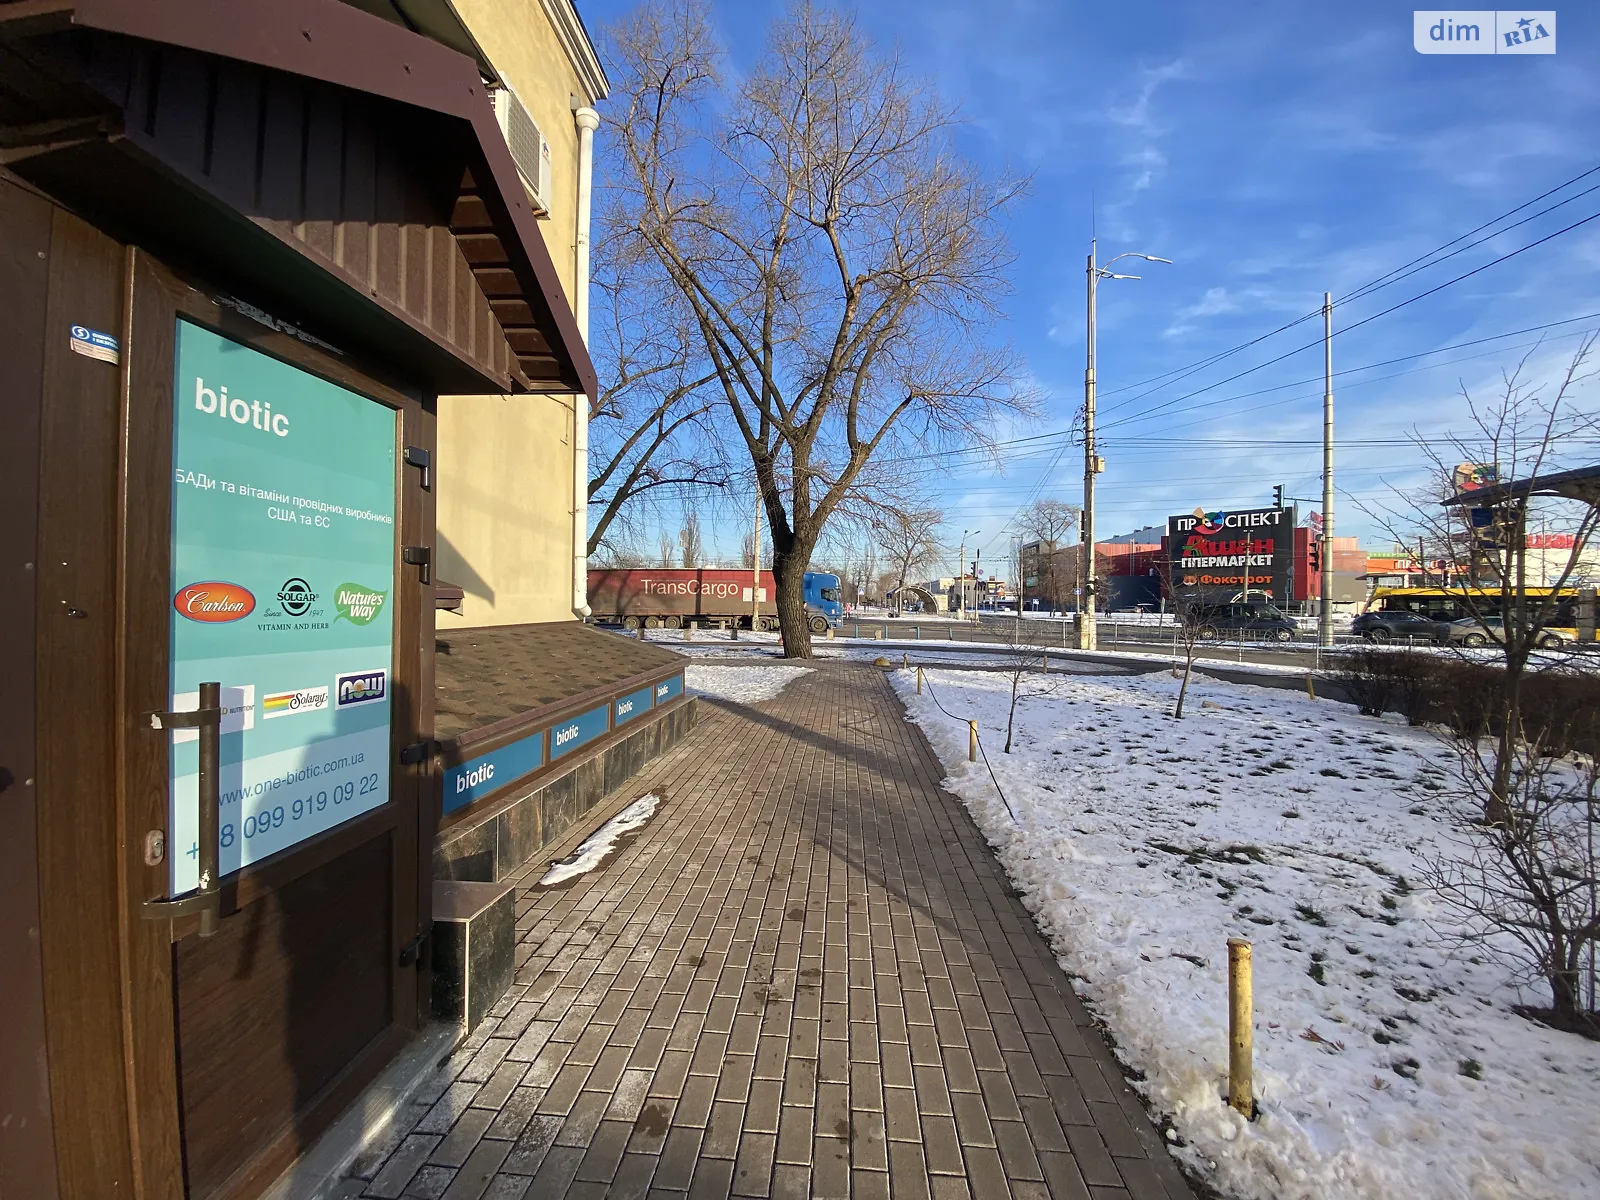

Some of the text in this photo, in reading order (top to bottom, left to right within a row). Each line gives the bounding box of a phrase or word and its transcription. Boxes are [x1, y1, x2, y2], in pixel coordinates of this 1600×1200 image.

[194, 377, 291, 438] biotic
[175, 468, 393, 525] БАДи та вітаміни провідних виробників
[267, 507, 331, 529] США та ЄС
[1181, 554, 1274, 568] ГІПЕРМАРКЕТ
[276, 592, 316, 602] SOLGAR
[640, 578, 739, 599] TransCargo
[185, 588, 246, 613] Carlson
[263, 608, 282, 618] Since
[350, 605, 376, 621] Way
[257, 623, 292, 631] VITAMIN
[311, 622, 329, 630] HERB
[657, 684, 669, 697] biotic
[229, 705, 253, 714] NUTRITION
[289, 692, 328, 710] Solaray
[618, 700, 634, 716] biotic
[556, 724, 580, 746] biotic
[455, 762, 495, 794] biotic
[243, 806, 285, 839] 099
[291, 791, 328, 821] 919
[333, 780, 355, 805] 09
[359, 772, 379, 797] 22
